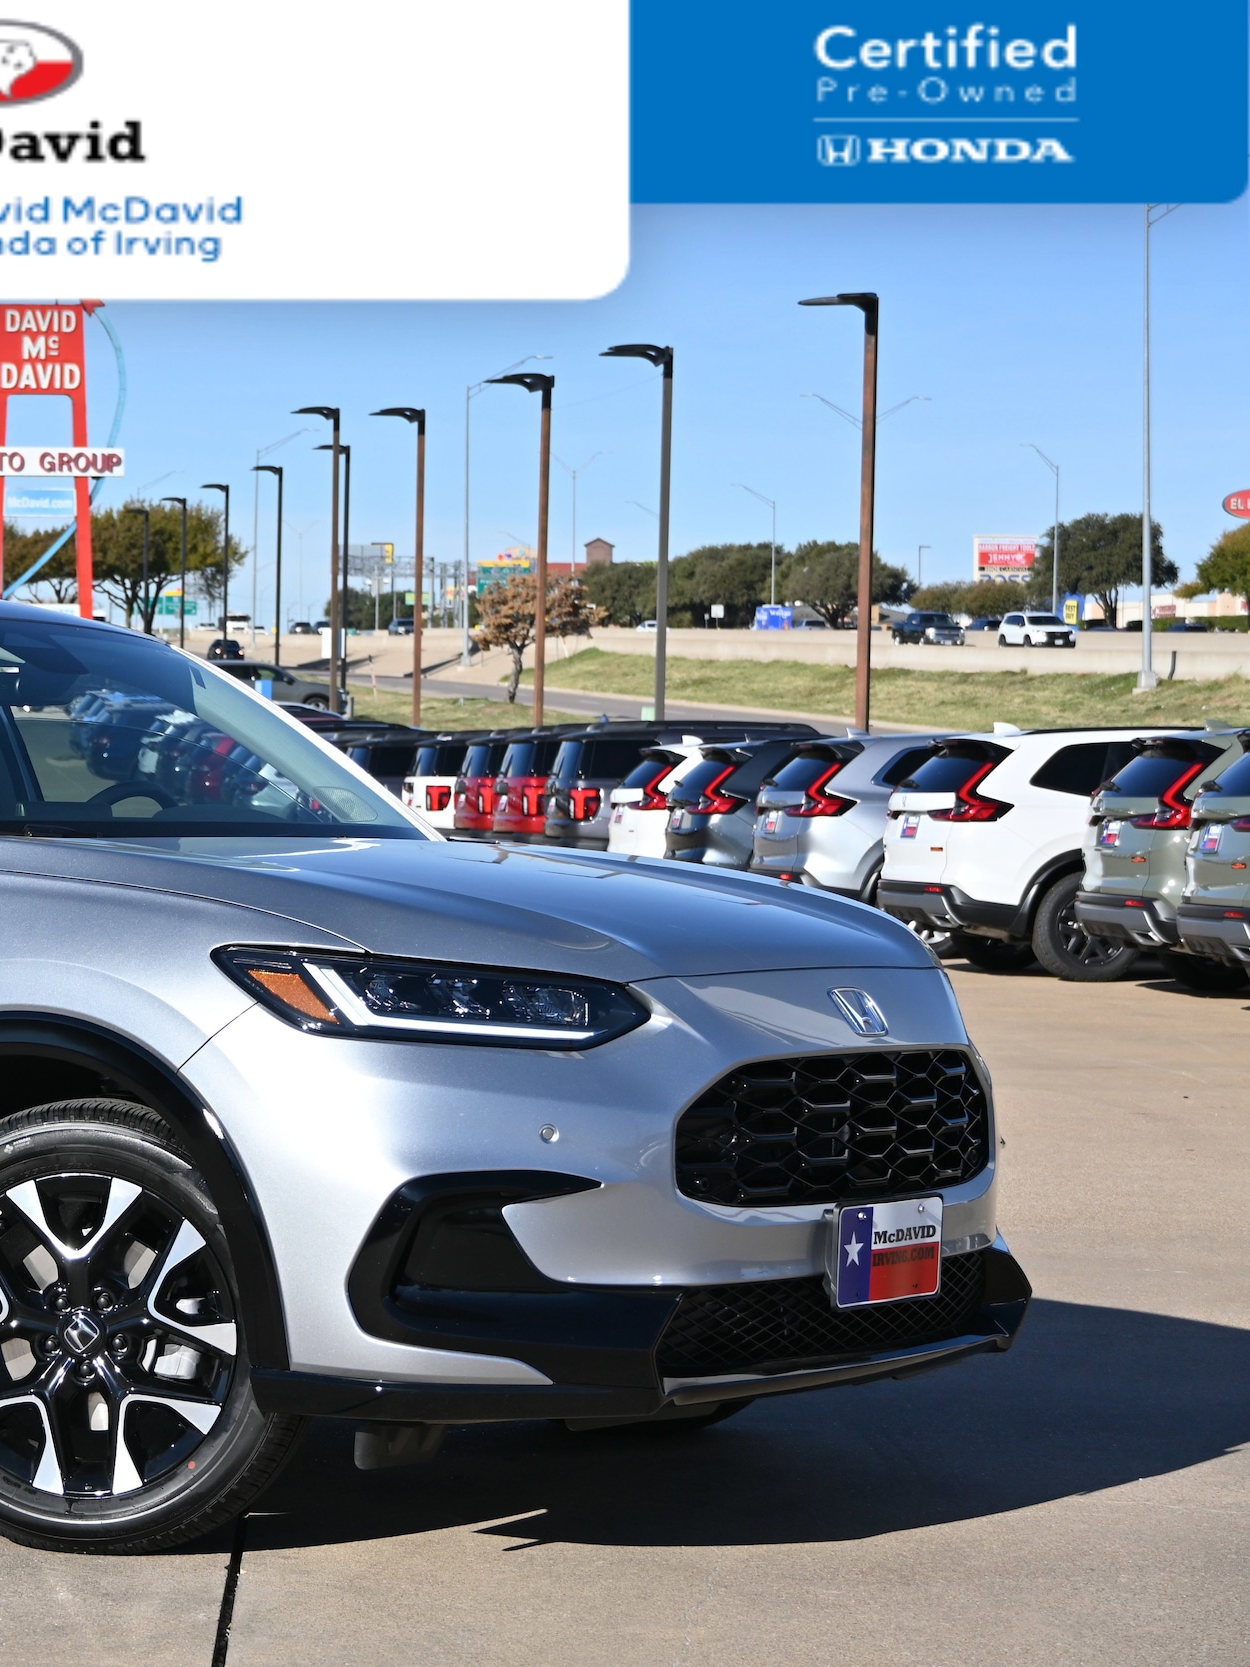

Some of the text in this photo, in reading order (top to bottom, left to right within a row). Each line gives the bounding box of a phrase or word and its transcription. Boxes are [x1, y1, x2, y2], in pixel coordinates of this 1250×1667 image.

[5, 309, 77, 333] DAVID
[0, 362, 81, 390] DAVID
[39, 452, 123, 474] GROUP
[7, 496, 73, 509] McDavid.com
[1230, 498, 1245, 510] EL
[873, 1224, 937, 1245] McDAVID
[872, 1246, 935, 1267] IRVING.COM
